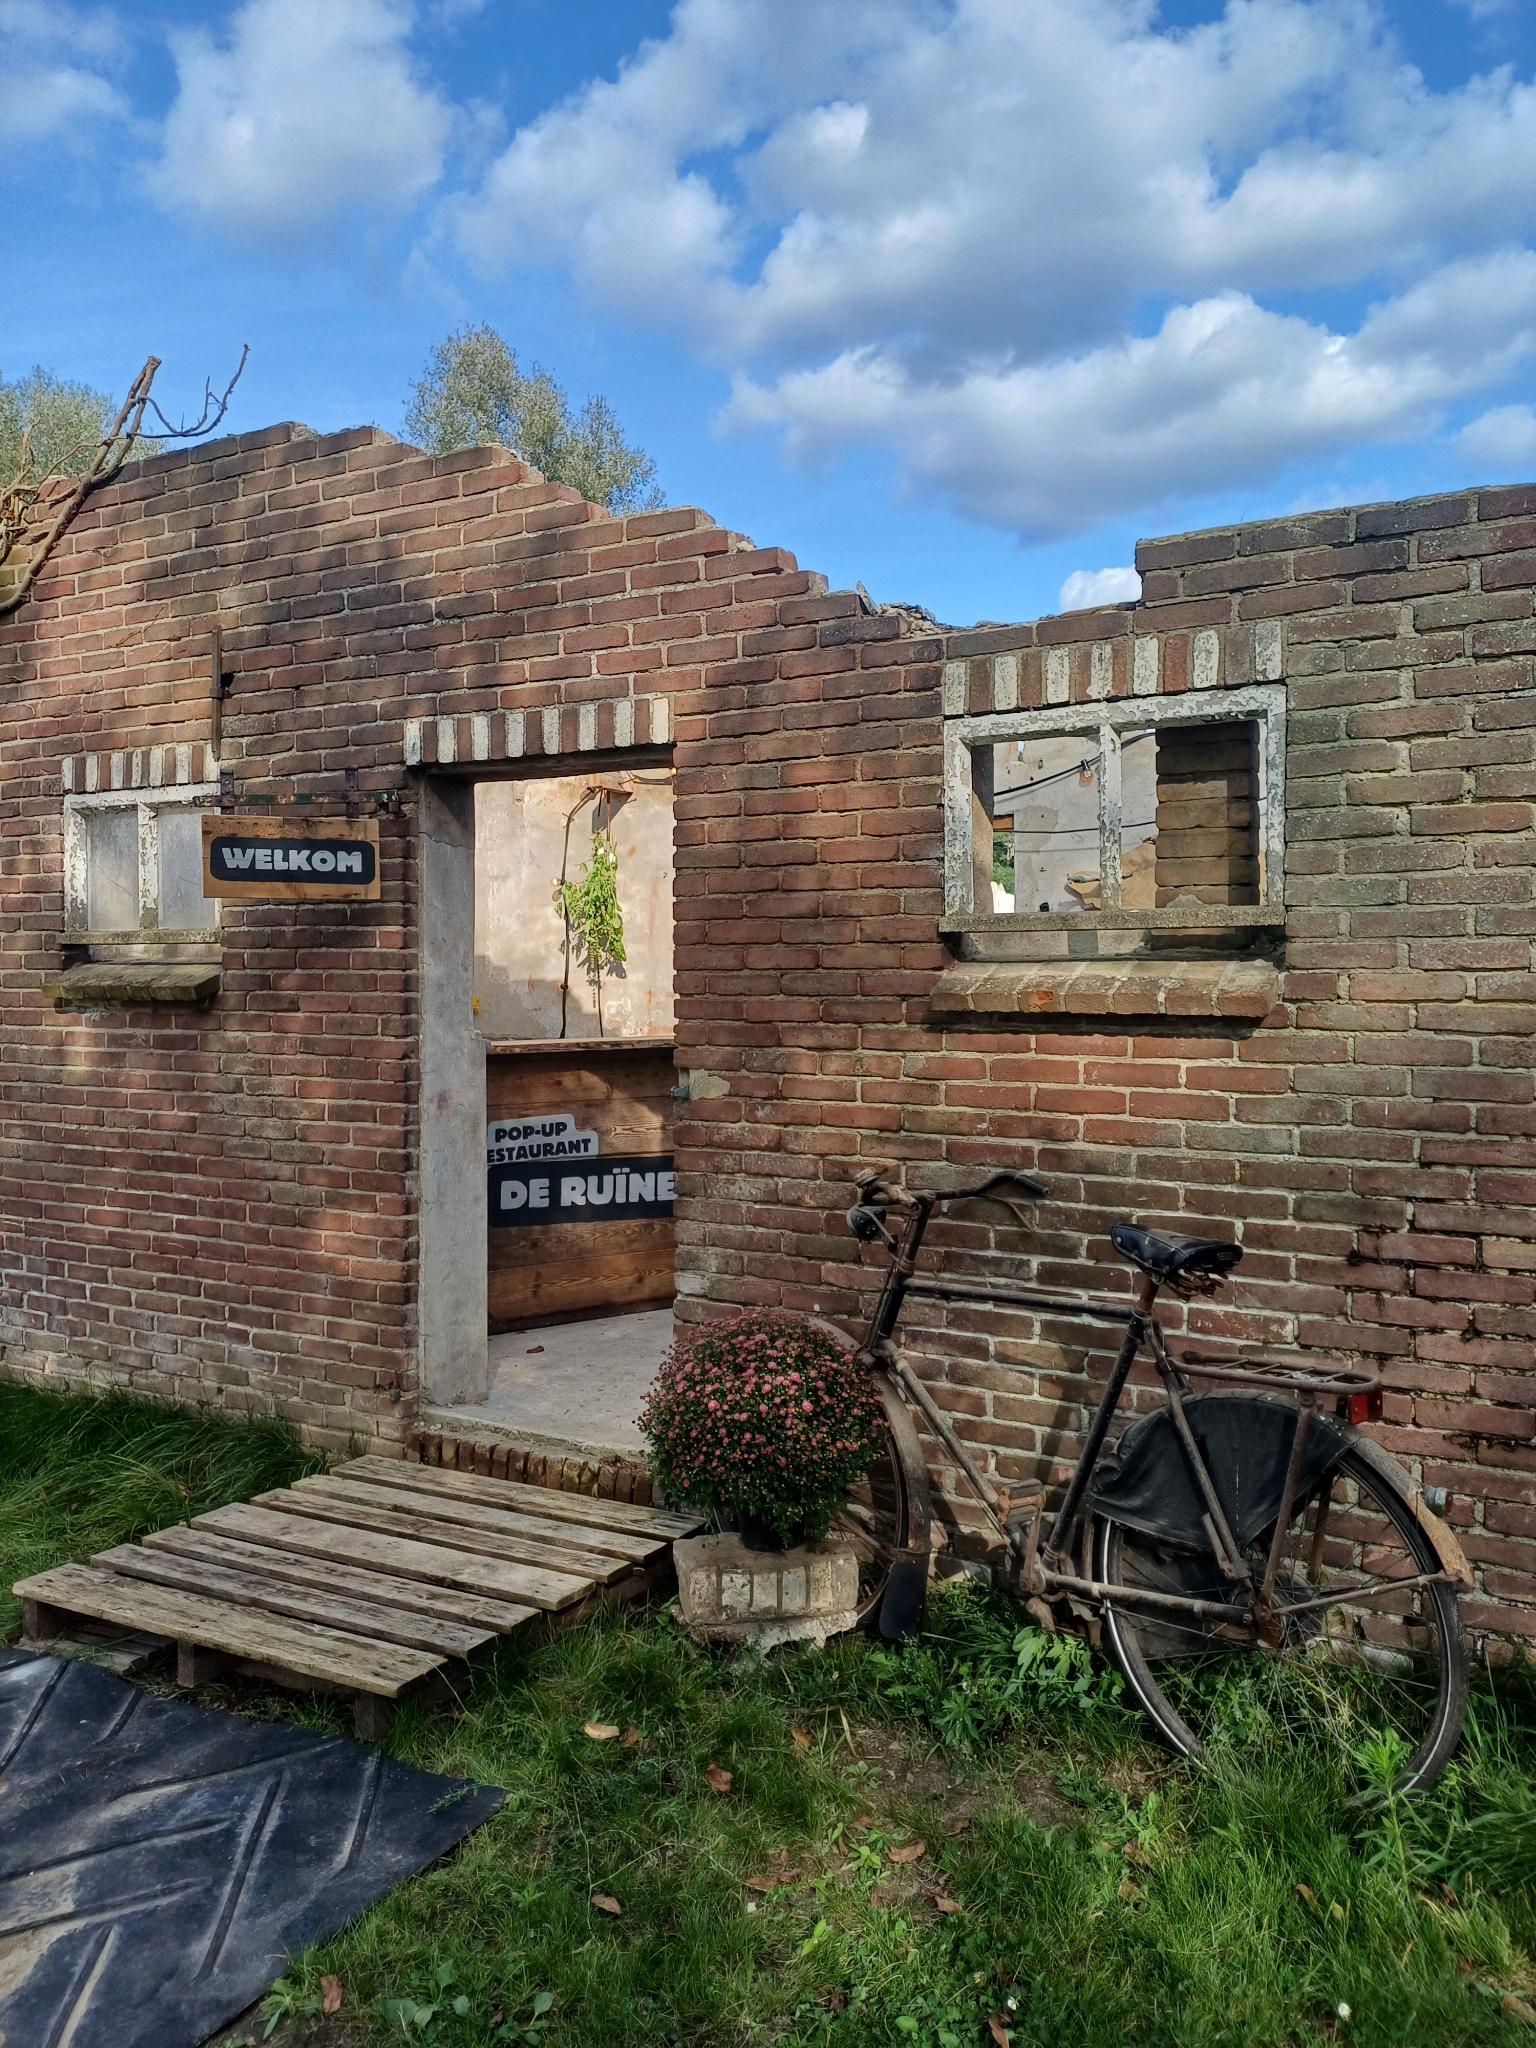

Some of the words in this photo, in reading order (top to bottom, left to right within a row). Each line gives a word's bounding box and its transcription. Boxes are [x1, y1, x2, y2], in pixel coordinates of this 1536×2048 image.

[221, 847, 363, 873] WELKOM
[495, 1121, 568, 1143] POP-UP
[487, 1138, 591, 1164] ESTAURANT
[500, 1178, 550, 1210] DE
[560, 1167, 677, 1207] RUÏNE
